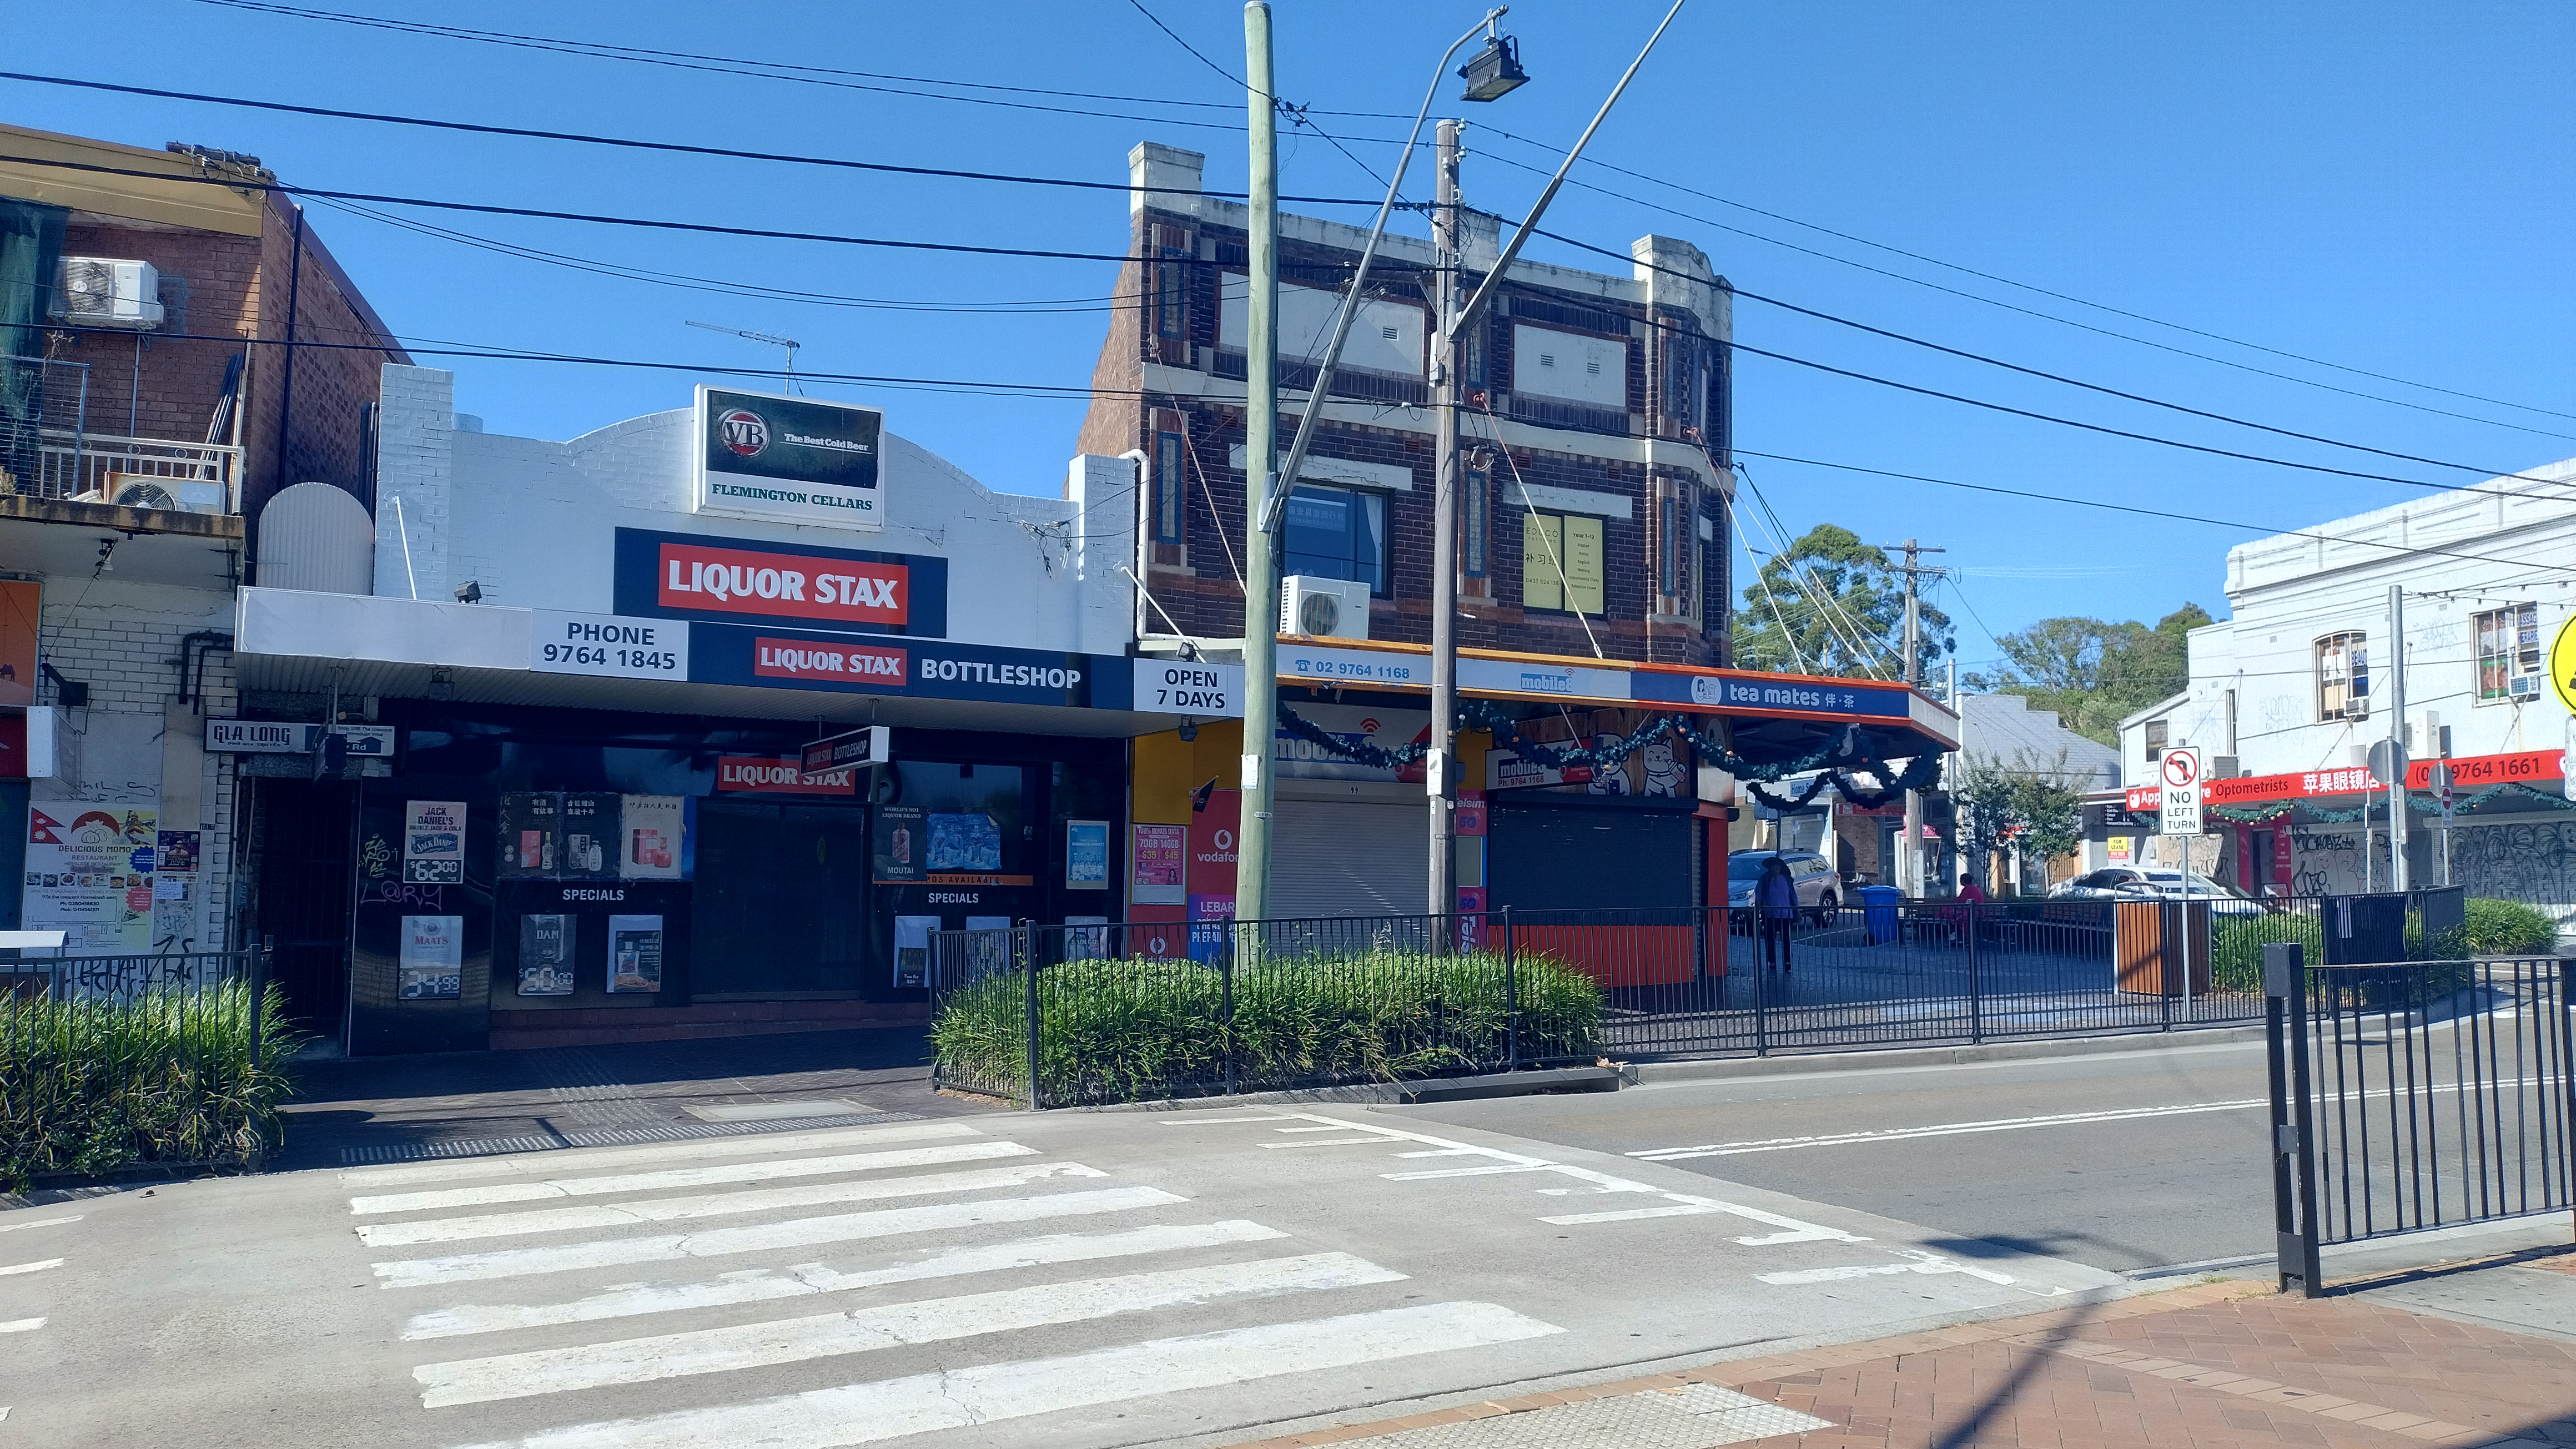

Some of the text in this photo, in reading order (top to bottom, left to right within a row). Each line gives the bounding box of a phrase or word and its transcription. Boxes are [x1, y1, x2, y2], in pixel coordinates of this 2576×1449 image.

[725, 420, 764, 449] VB
[784, 432, 869, 451] The Best Cold Beer
[712, 484, 873, 511] FLEMINGTON CELLARS
[668, 559, 898, 610] LIQUOR STAX
[567, 622, 655, 646] PHONE
[543, 643, 676, 670] 9764 1845
[760, 647, 1081, 689] LIQUOR STAX BOTTLESHOP
[1316, 661, 1410, 680] 02 9764 1168
[1165, 668, 1217, 688] OPEN
[1156, 689, 1226, 710] 7 DAYS
[1729, 682, 1759, 702] tea
[1764, 687, 1820, 707] mates
[250, 726, 290, 746] LONG
[834, 739, 867, 760] BOTTLESHOP
[723, 765, 797, 786] LIQUOR
[2452, 761, 2493, 779] 9764
[2499, 757, 2539, 776] 1661
[1498, 776, 1544, 787] Ph: 9764 1168
[1791, 783, 1805, 794] Home
[2216, 779, 2288, 798] Optometrists
[2303, 767, 2380, 796] 苹果眼镜店
[1457, 797, 1486, 808] elsim
[2170, 791, 2191, 804] NO
[418, 816, 454, 826] DANIEL'S
[425, 807, 447, 816] JACK
[2168, 807, 2193, 817] LEFT
[1459, 816, 1477, 828] 5G
[2167, 821, 2196, 829] TURN
[1139, 839, 1179, 848] 70GB 140GB
[1164, 851, 1178, 859] $45
[563, 889, 625, 900] SPECIALS
[928, 892, 979, 904] SPECIALS
[1459, 897, 1477, 909] 5G
[1200, 901, 1235, 913] LEBAR
